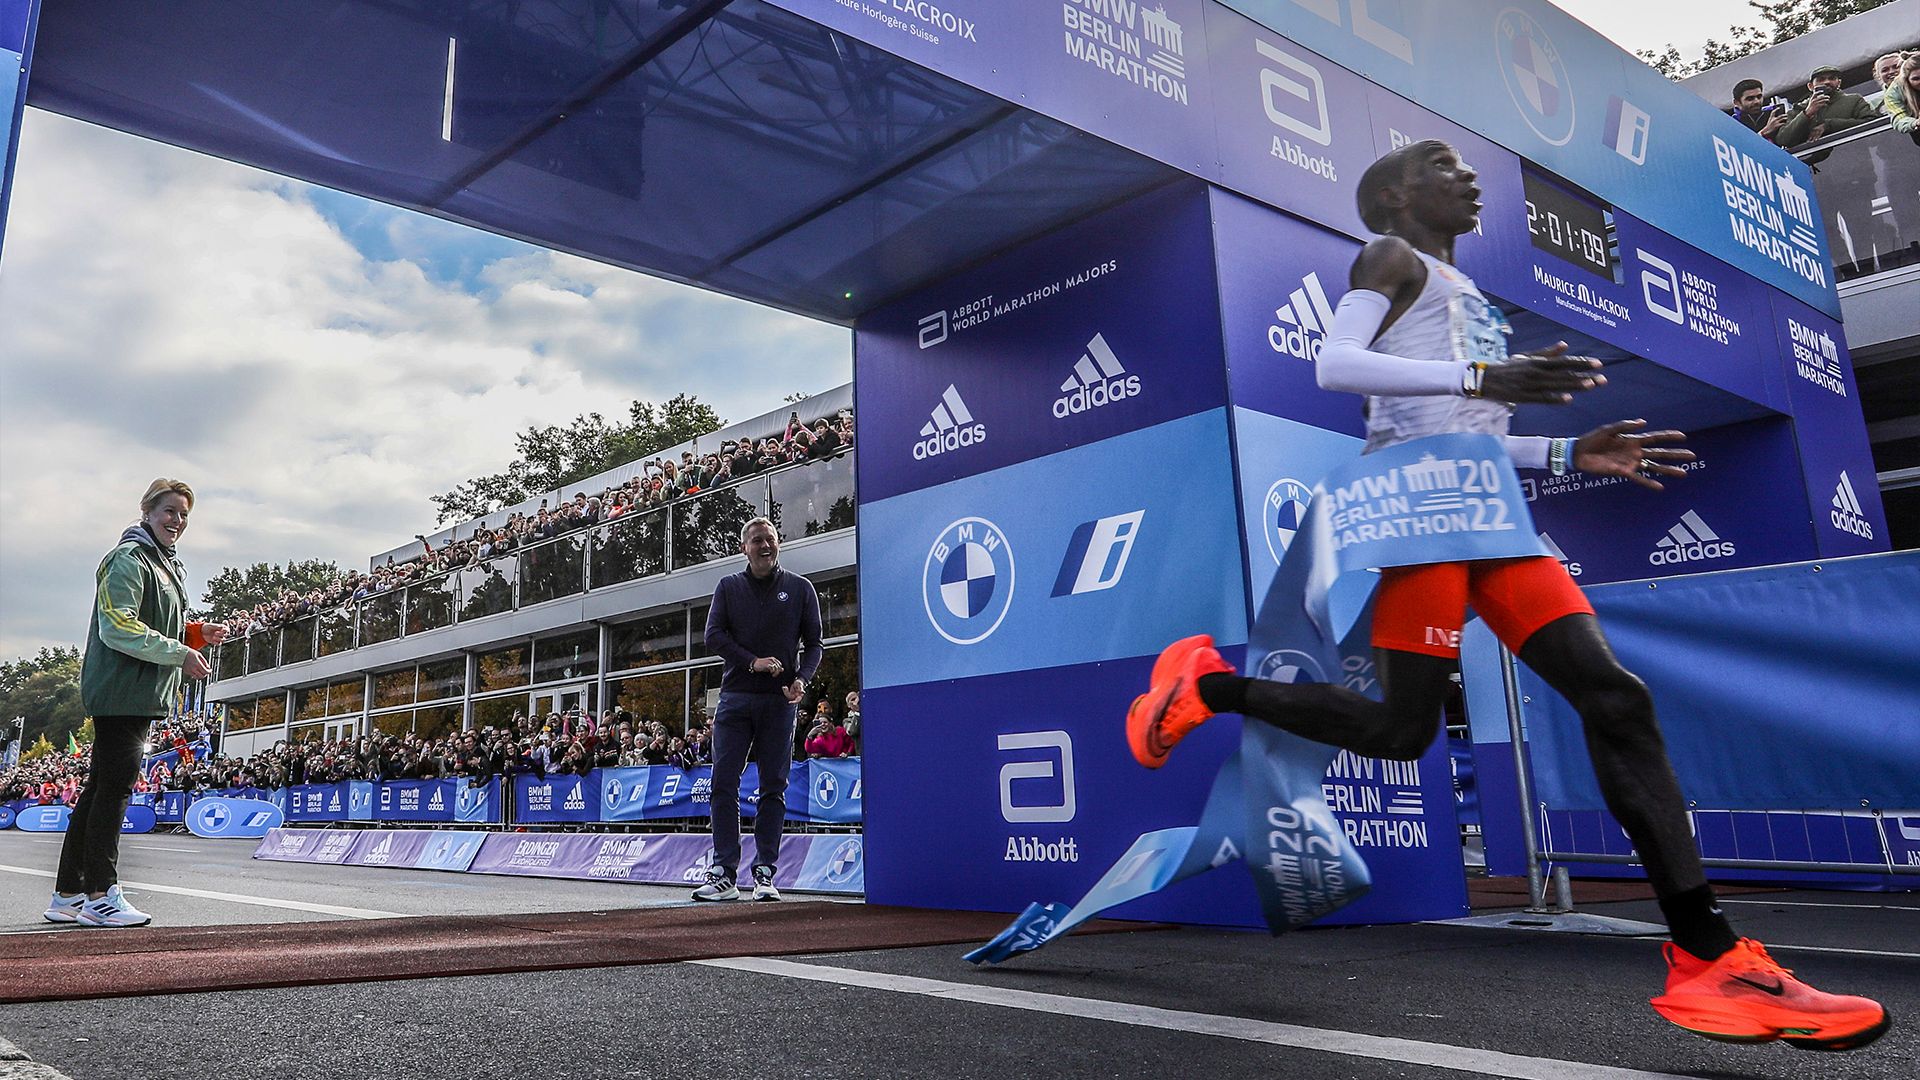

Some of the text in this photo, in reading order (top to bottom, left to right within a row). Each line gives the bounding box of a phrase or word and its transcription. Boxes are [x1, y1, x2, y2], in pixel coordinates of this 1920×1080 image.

[862, 3, 907, 31] Horlogère
[910, 23, 939, 45] Suisse
[1063, 3, 1141, 59] BERLIN
[1065, 31, 1188, 106] MARATHON
[1270, 135, 1338, 183] Abbott
[1712, 134, 1775, 203] BMW
[1722, 178, 1787, 237] BERLIN
[1525, 200, 1606, 267] 2:01:09
[1729, 212, 1826, 289] MARATHON
[952, 260, 1117, 333] WORLD MARATHON MAJORS
[1533, 264, 1576, 299] MAURICE
[1592, 290, 1631, 322] LACROIX
[1682, 270, 1717, 297] ABBOTT
[1683, 284, 1718, 311] WORLD
[952, 295, 993, 321] ABBOTT
[1687, 301, 1740, 336] MARATHON
[1690, 317, 1729, 345] MAJORS
[1788, 318, 1819, 352] BMW
[1793, 342, 1825, 371] BERLIN
[1796, 360, 1847, 398] MARATHON
[1052, 375, 1142, 419] adidas
[912, 423, 987, 461] adidas
[1457, 459, 1500, 494] 20
[1541, 472, 1583, 488] ABBOTT
[1542, 480, 1581, 496] WORLD
[1333, 495, 1411, 531] ERLIN
[1464, 497, 1517, 532] 22
[1831, 509, 1874, 541] adidas
[933, 523, 1000, 564] BMW
[1649, 540, 1736, 567] adidas
[1326, 748, 1374, 780] MW
[563, 801, 585, 810] adidas
[1321, 783, 1382, 814] ERLIN
[1266, 806, 1304, 853] 20
[1341, 818, 1429, 849] RATHON
[362, 853, 390, 865] adidas
[513, 839, 560, 858] ERDINGER
[593, 855, 623, 866] BERLIN
[600, 840, 629, 856] BMW
[1003, 836, 1079, 863] Abbott
[587, 866, 633, 878] MARATHON
